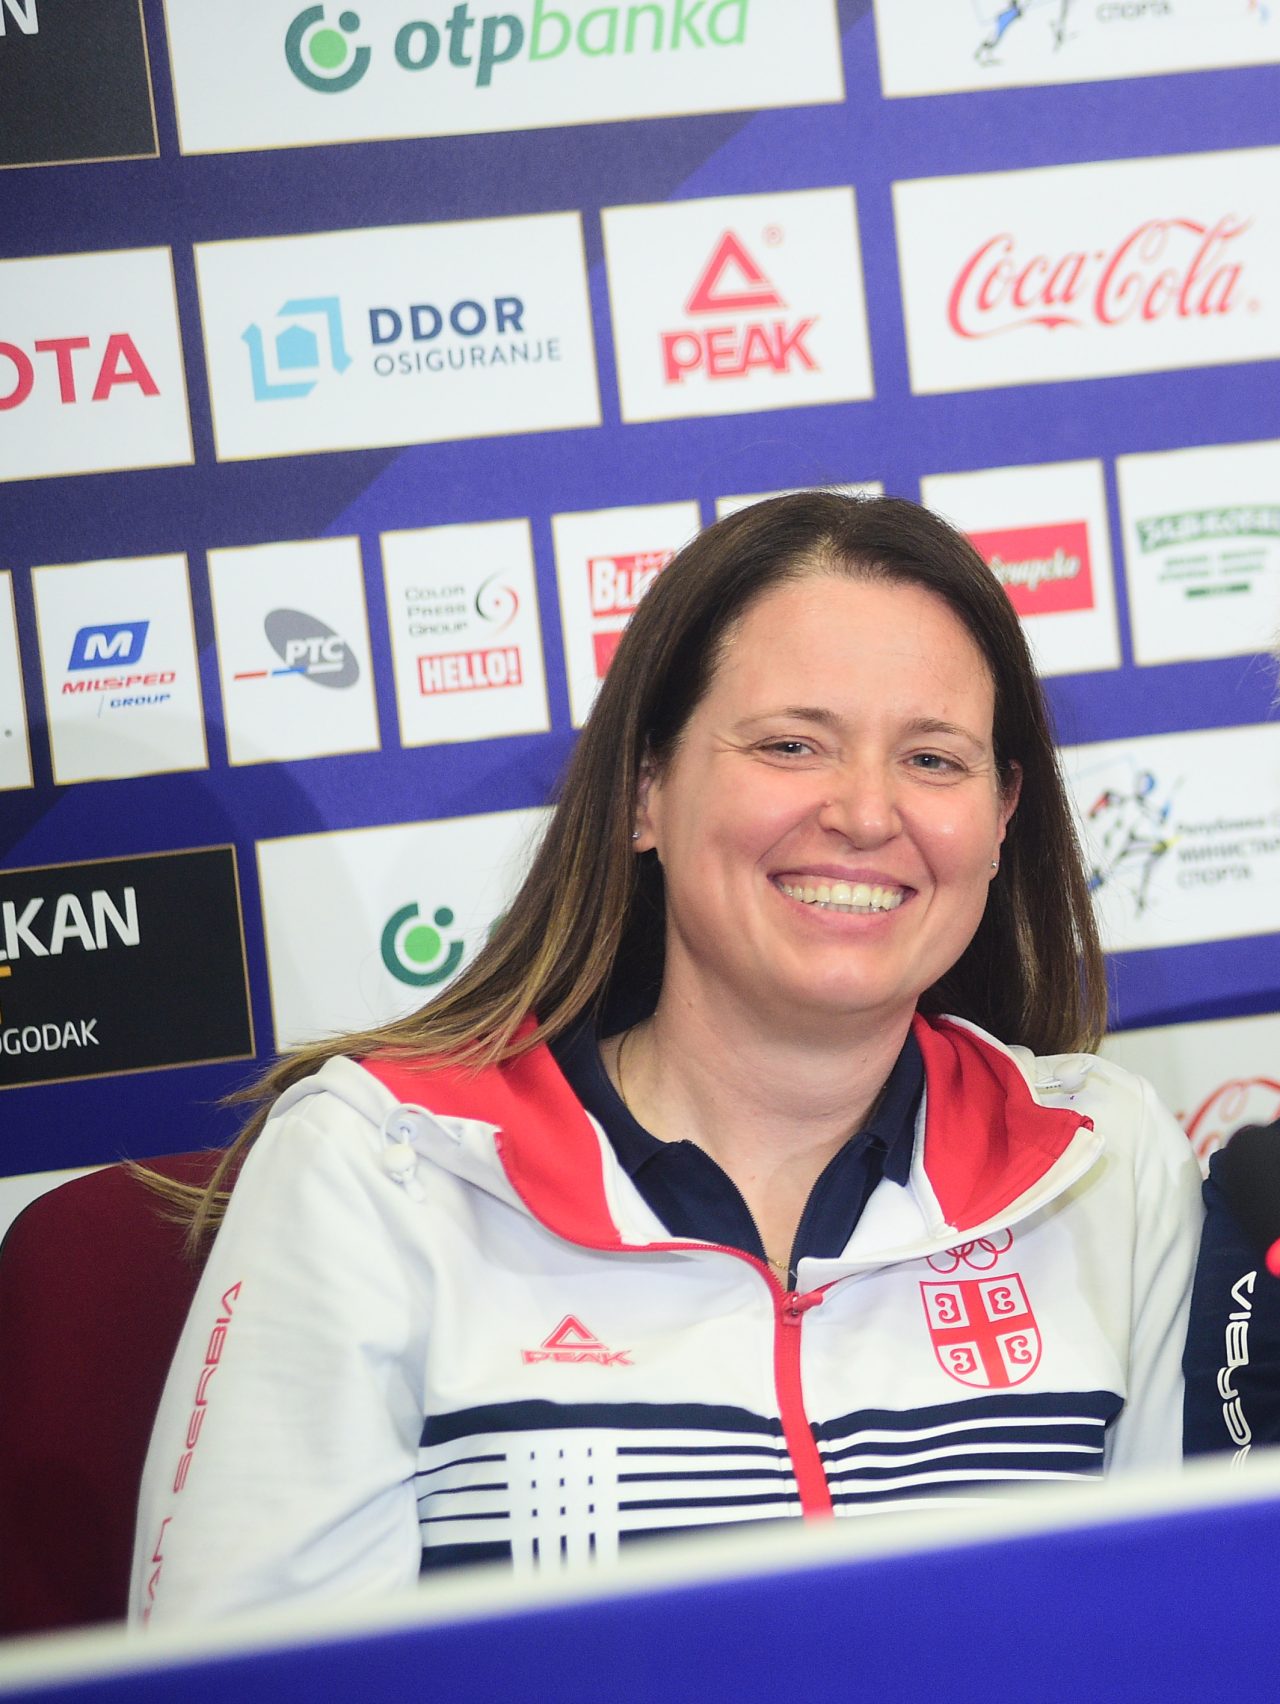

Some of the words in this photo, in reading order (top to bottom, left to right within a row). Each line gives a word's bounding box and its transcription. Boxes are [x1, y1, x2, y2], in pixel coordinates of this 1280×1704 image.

[394, 0, 749, 88] otpbanka
[947, 214, 1253, 340] Coca-Cola
[369, 296, 526, 344] DDOR
[373, 337, 562, 377] OSIGURANJE
[660, 316, 821, 385] PEAK
[61, 671, 176, 695] MILSPED
[421, 650, 519, 694] HELLO!
[110, 694, 171, 709] GROUP
[0, 886, 140, 961] KAN
[0, 1018, 100, 1055] GODAK
[521, 1349, 635, 1367] PEAK
[172, 1280, 243, 1494] SERBIA
